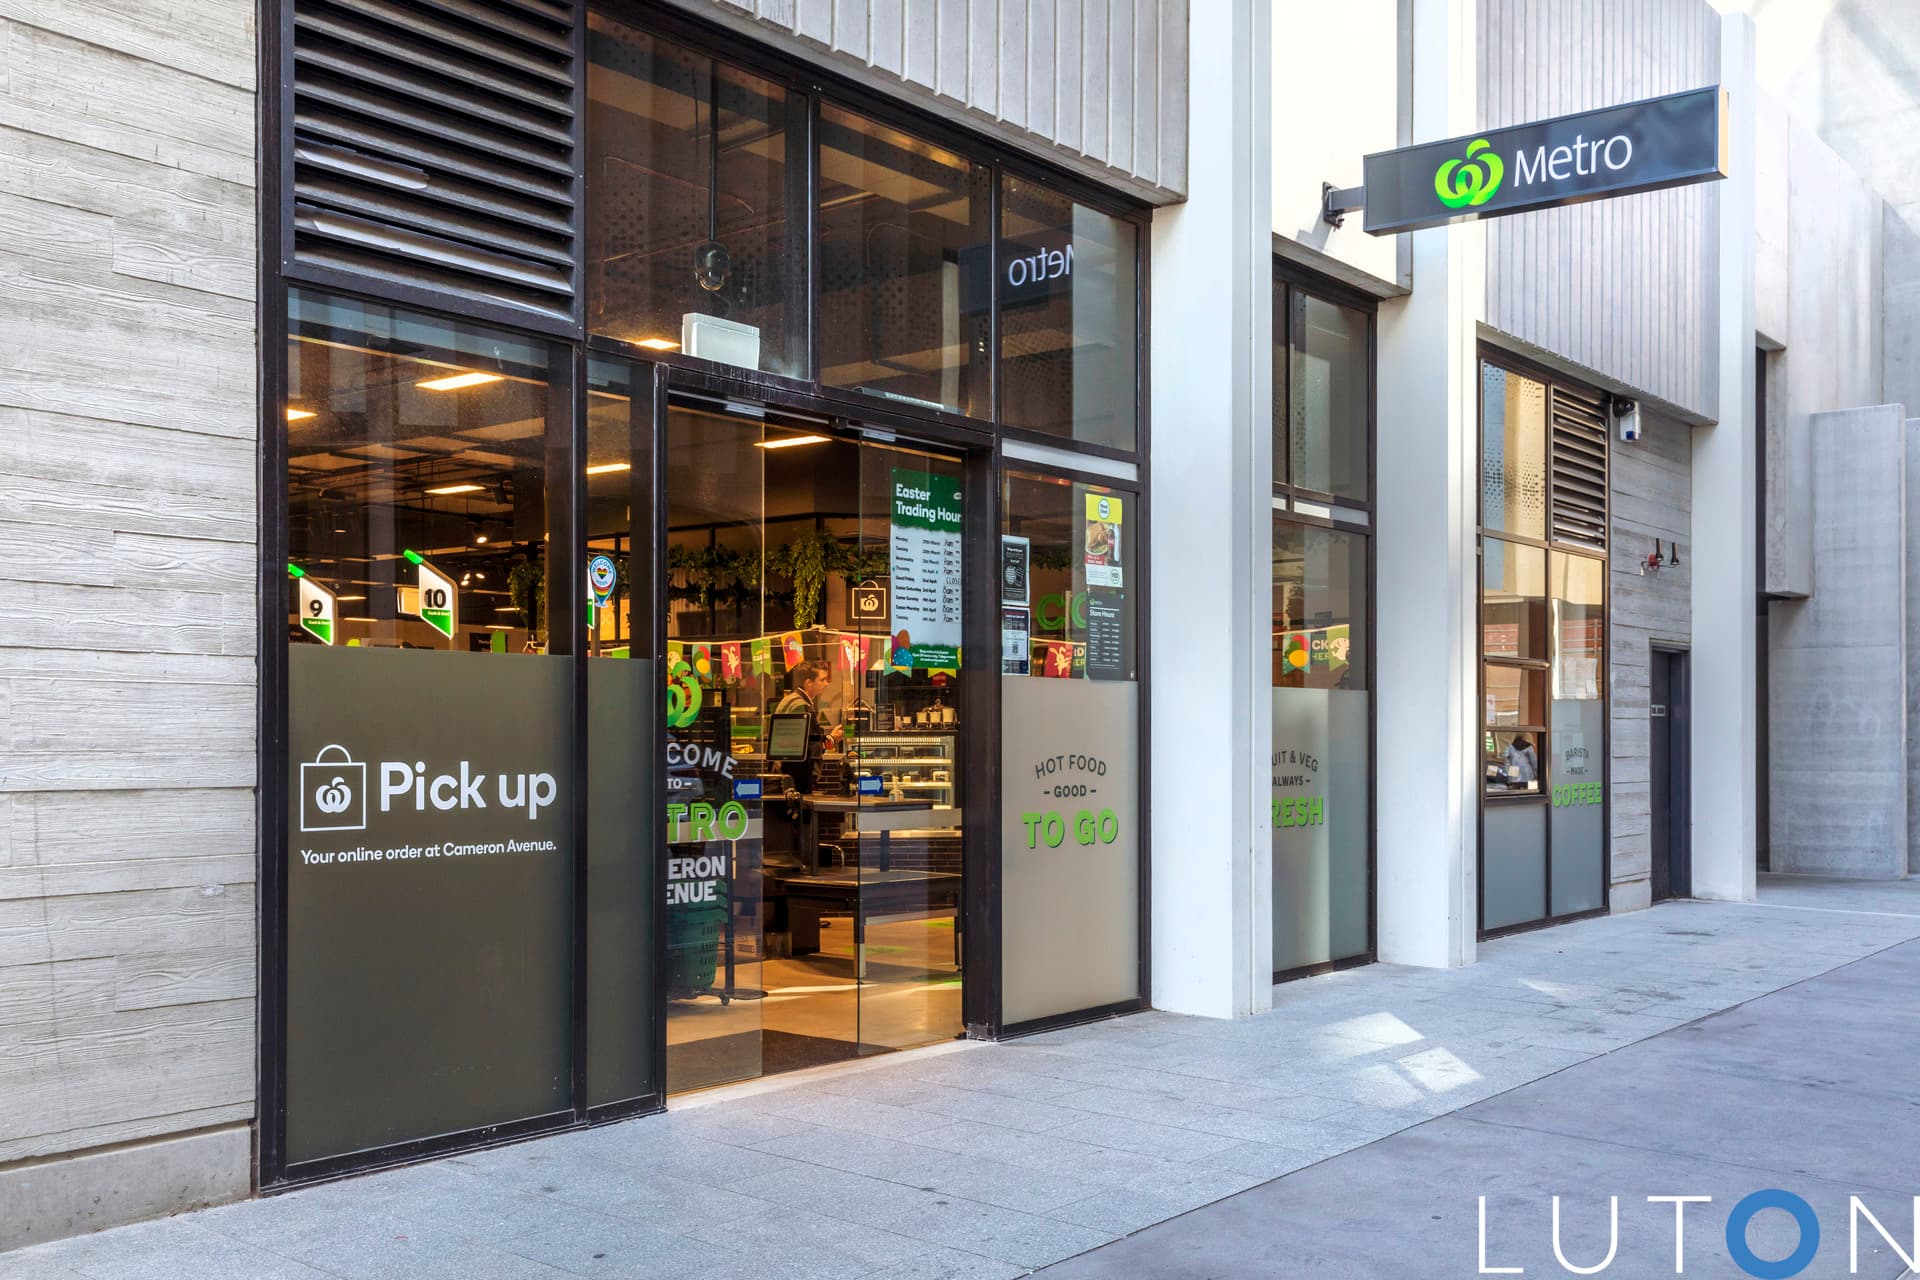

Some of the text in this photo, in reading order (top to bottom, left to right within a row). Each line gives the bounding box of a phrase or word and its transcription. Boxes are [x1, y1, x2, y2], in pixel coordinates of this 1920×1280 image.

[1514, 134, 1632, 187] Metro
[896, 483, 931, 500] Easter
[896, 500, 936, 523] Trading
[309, 599, 323, 618] 9
[424, 588, 447, 609] 10
[1090, 609, 1115, 619] Store Hours
[667, 742, 738, 780] COME
[1035, 754, 1106, 779] HOT FOOD
[1290, 750, 1296, 764] &
[1299, 752, 1318, 772] VEG
[381, 761, 557, 820] Pick up
[1552, 783, 1602, 808] COFFEE
[667, 801, 749, 843] TRO
[1021, 807, 1119, 849] TO GO
[301, 839, 557, 865] Your online order at Cameron Avenue.
[668, 856, 726, 880] ERON
